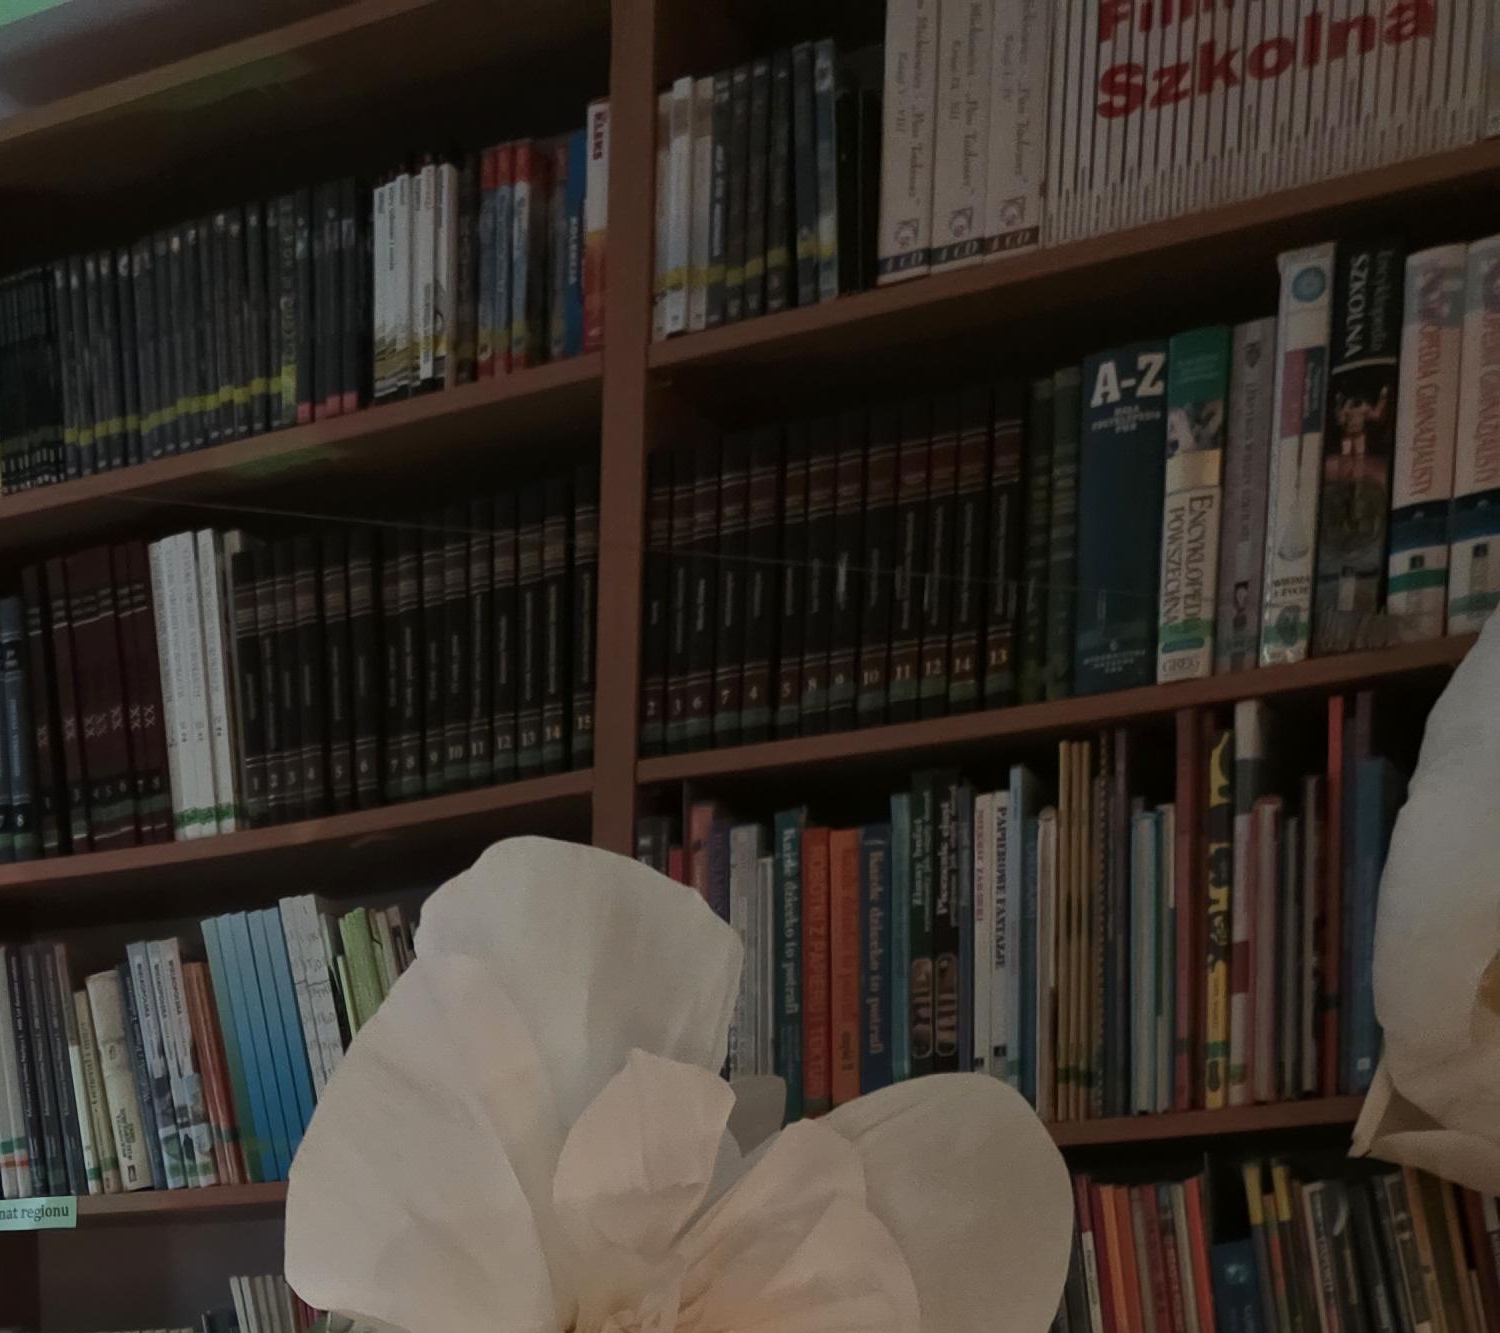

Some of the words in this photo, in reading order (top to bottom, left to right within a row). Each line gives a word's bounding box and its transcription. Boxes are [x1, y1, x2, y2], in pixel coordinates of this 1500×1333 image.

[1097, 0, 1437, 119] Szkolna
[1346, 253, 1370, 360] SZKOLNA
[1089, 351, 1167, 409] A-Z
[1183, 494, 1214, 620] ENCYKLOPED
[782, 827, 799, 875] Każde
[868, 849, 886, 902] Każde
[996, 806, 1008, 895] PAPIEROWE
[783, 880, 799, 939] dziecko
[868, 906, 885, 971] dziecko
[995, 897, 1007, 969] FANTAZJE
[786, 942, 798, 960] to
[781, 962, 799, 1014] potrafi
[870, 975, 884, 991] to
[866, 995, 885, 1054] potrafi
[21, 1204, 69, 1222] regionu
